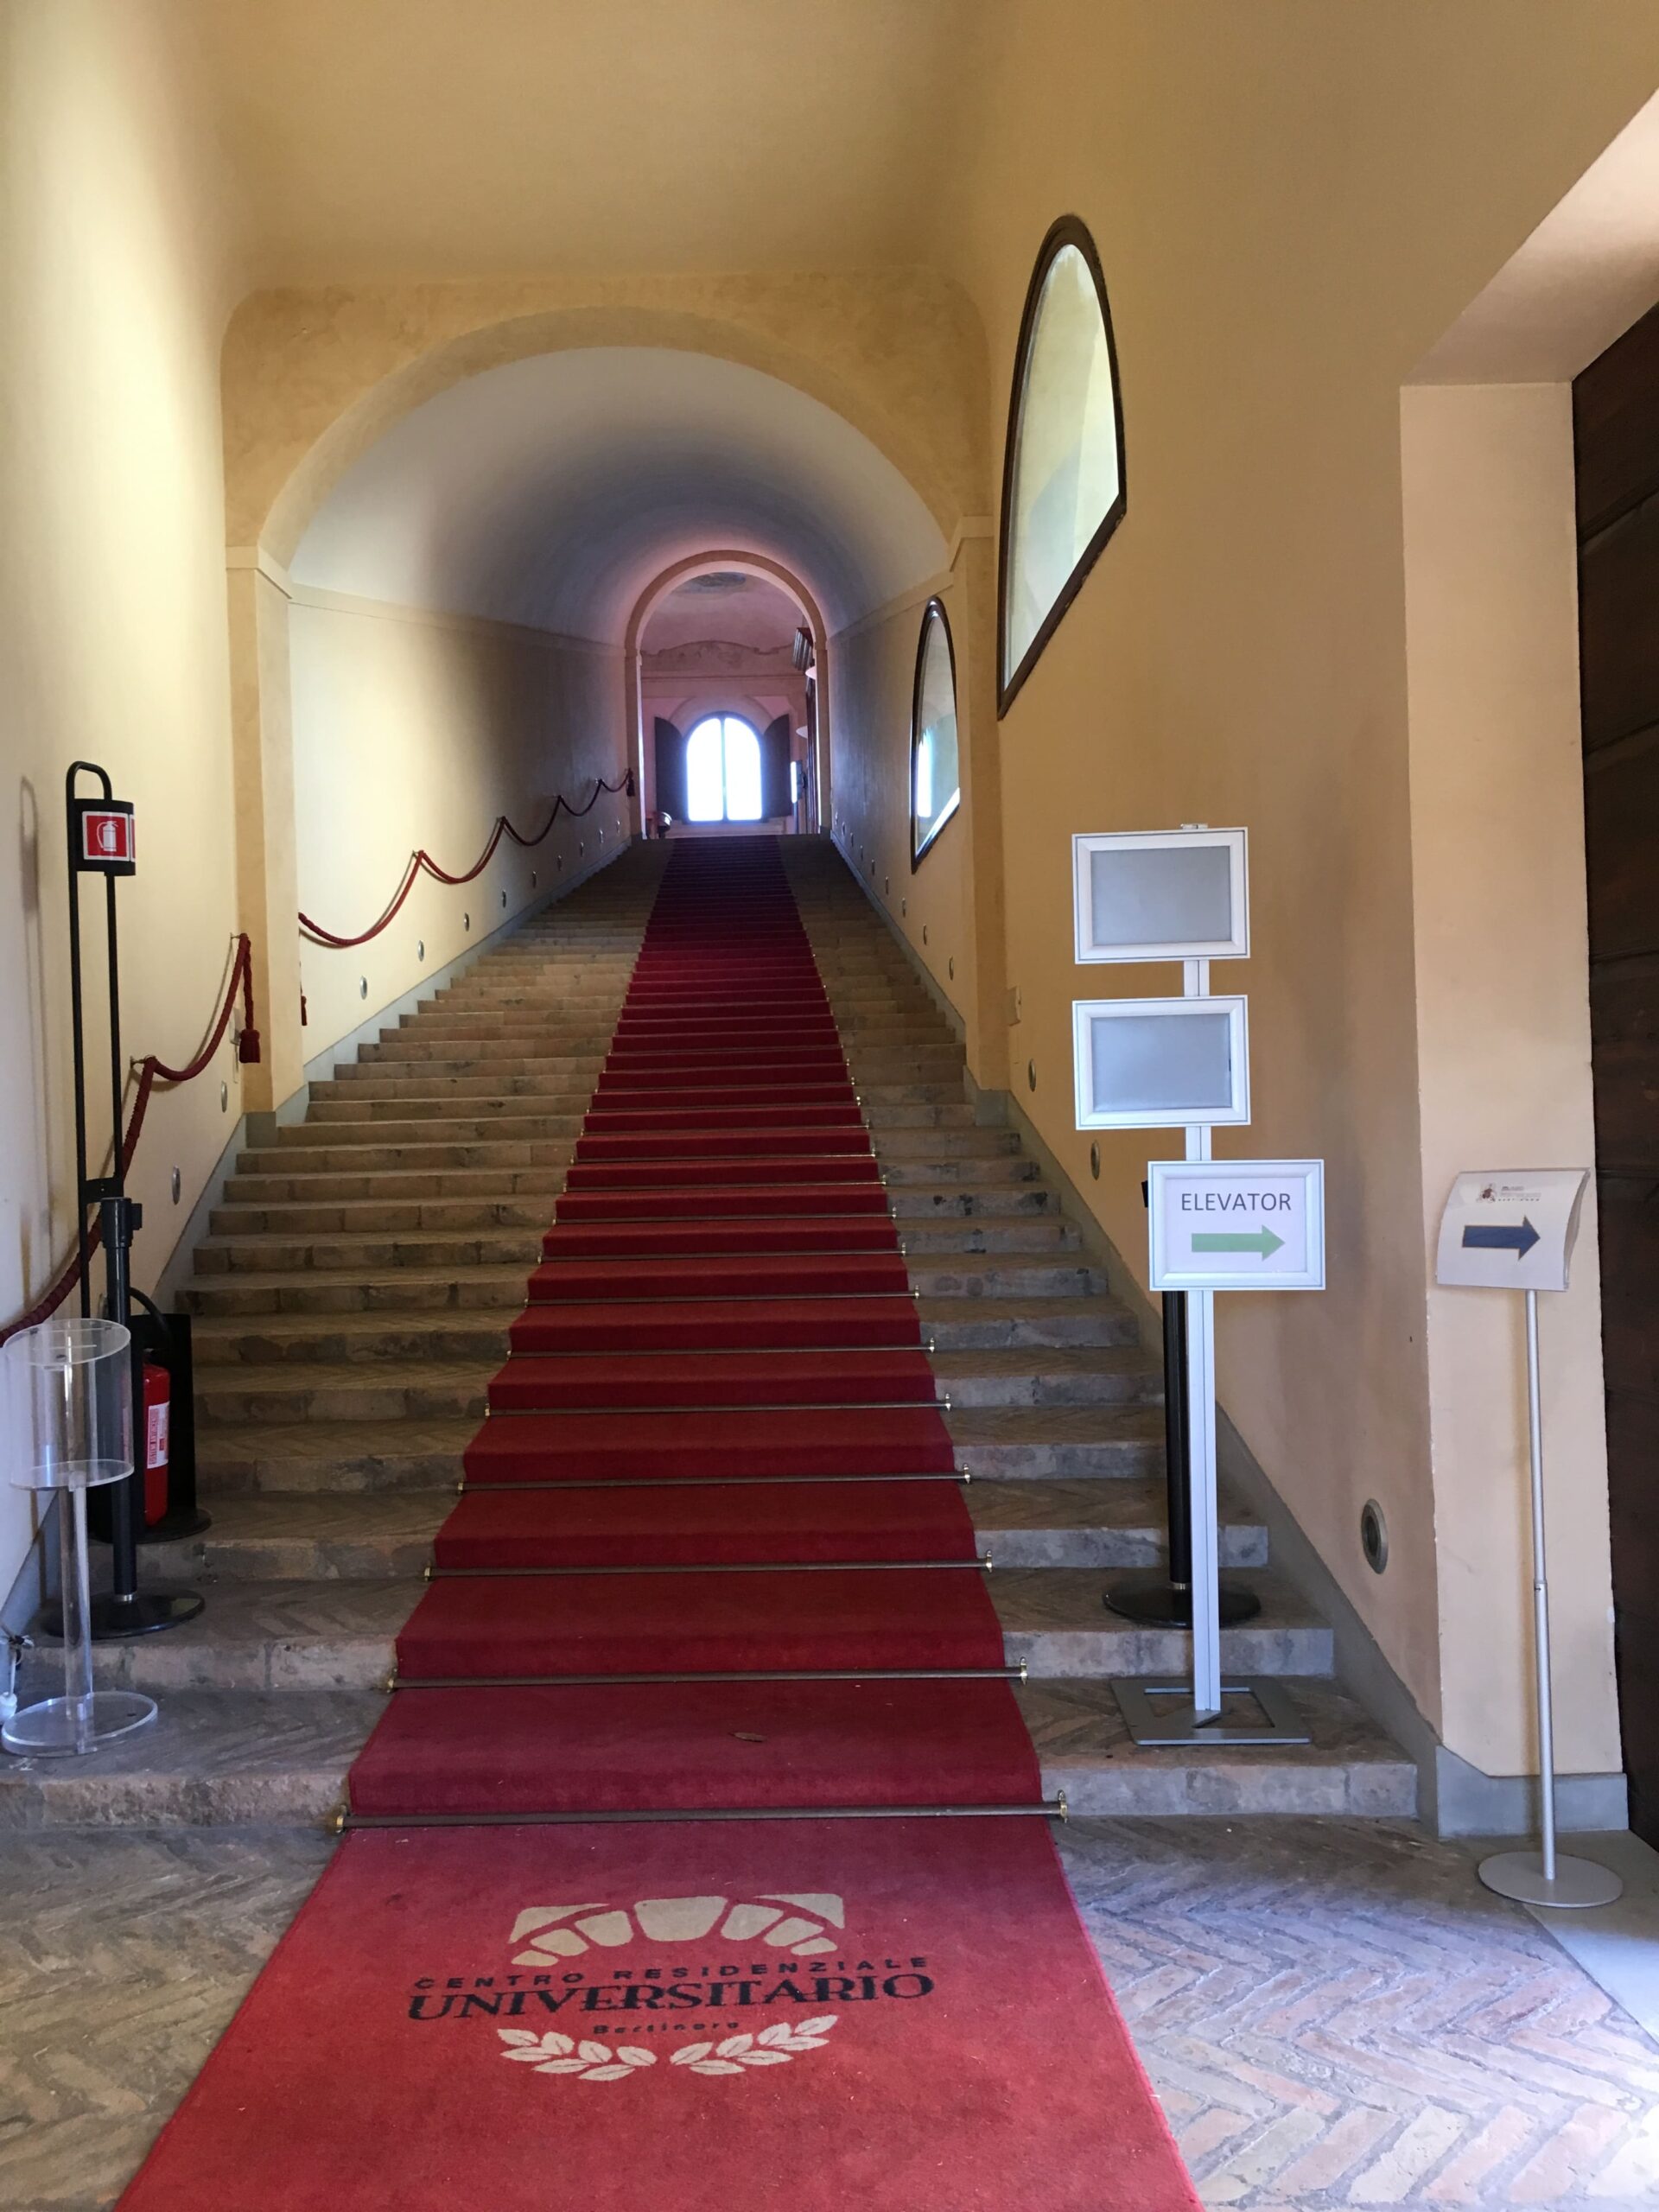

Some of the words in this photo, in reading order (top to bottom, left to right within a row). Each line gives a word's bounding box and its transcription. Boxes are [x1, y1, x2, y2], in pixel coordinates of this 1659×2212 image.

[1181, 1192, 1292, 1211] ELEVATOR
[414, 1972, 584, 1989] CENTRO
[613, 1957, 927, 1980] RESIDENZIALE
[408, 1974, 935, 2020] UNIVERSITARIO
